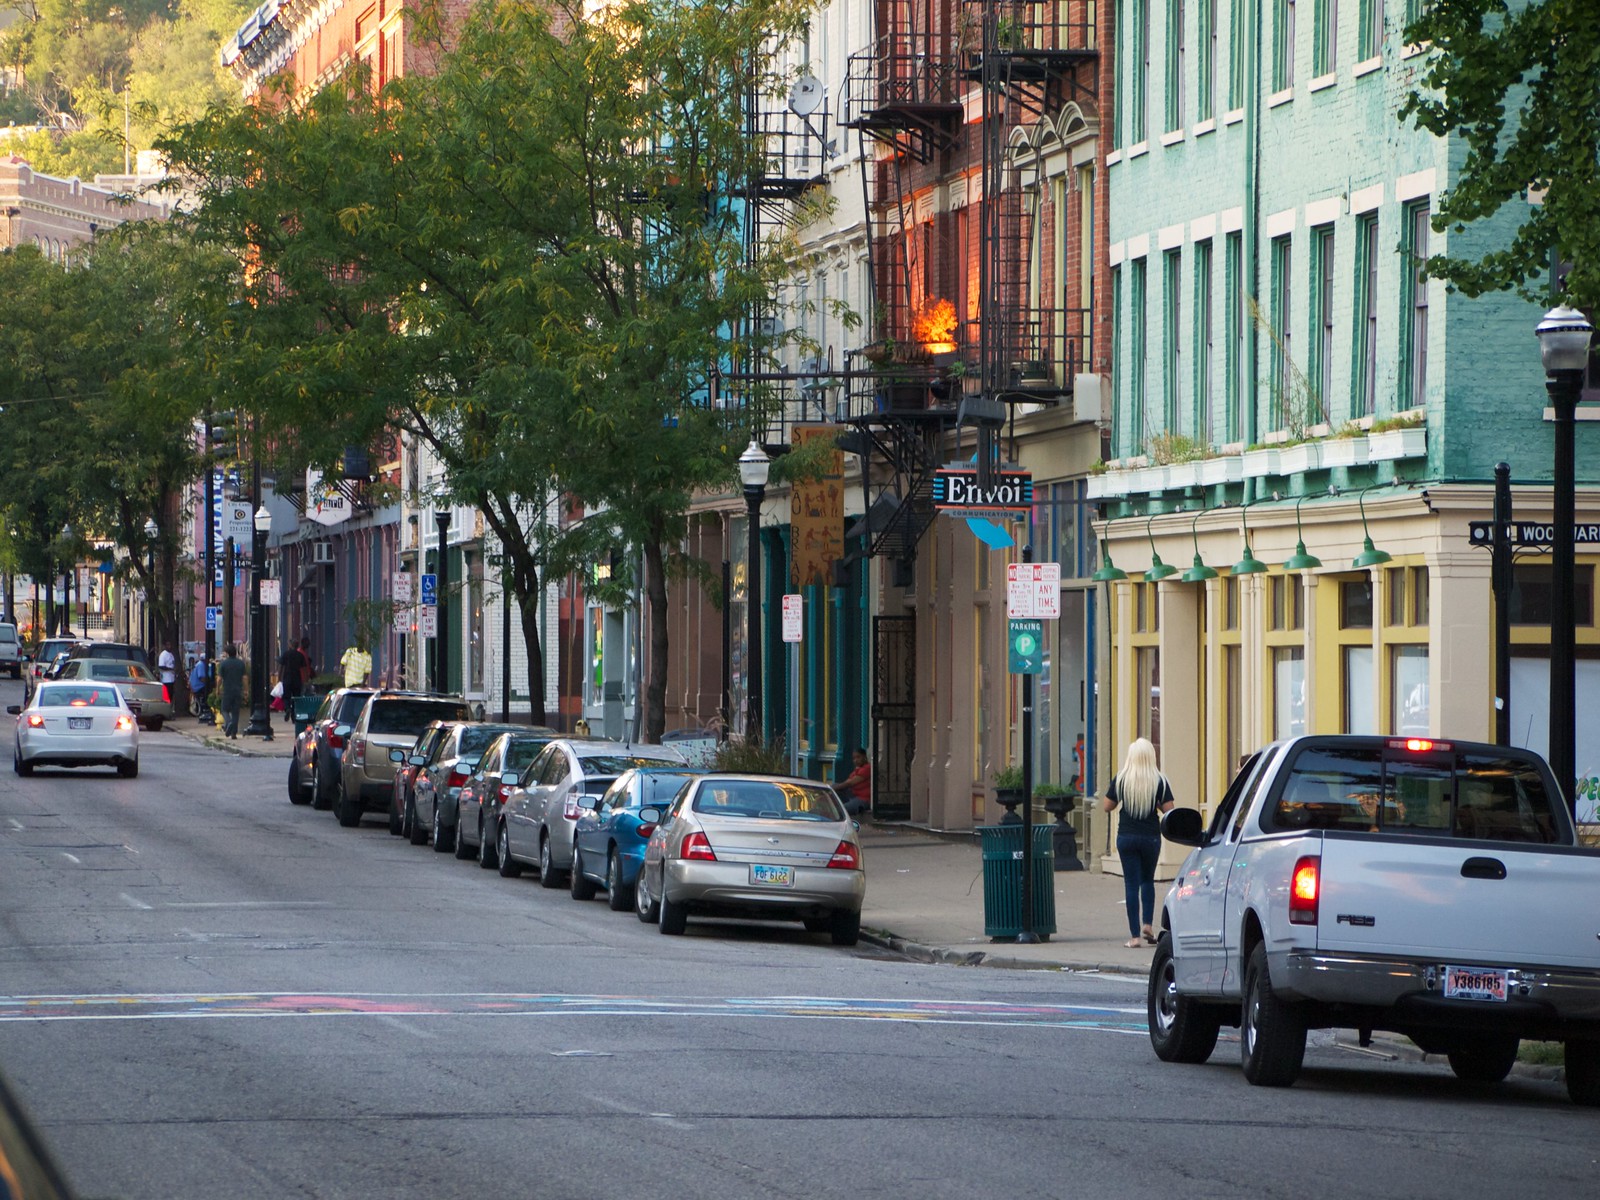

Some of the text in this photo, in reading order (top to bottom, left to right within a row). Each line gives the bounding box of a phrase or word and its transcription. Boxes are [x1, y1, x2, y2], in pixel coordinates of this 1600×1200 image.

[947, 476, 1020, 504] Envoi
[953, 510, 1014, 518] COMMUNICATION
[1523, 526, 1600, 541] WOOAR
[1038, 585, 1053, 594] ANY
[1038, 598, 1055, 608] TIME
[1010, 622, 1041, 631] PARKING
[1021, 637, 1031, 653] P
[769, 871, 787, 881] 6122
[1454, 975, 1500, 990] Y386185
